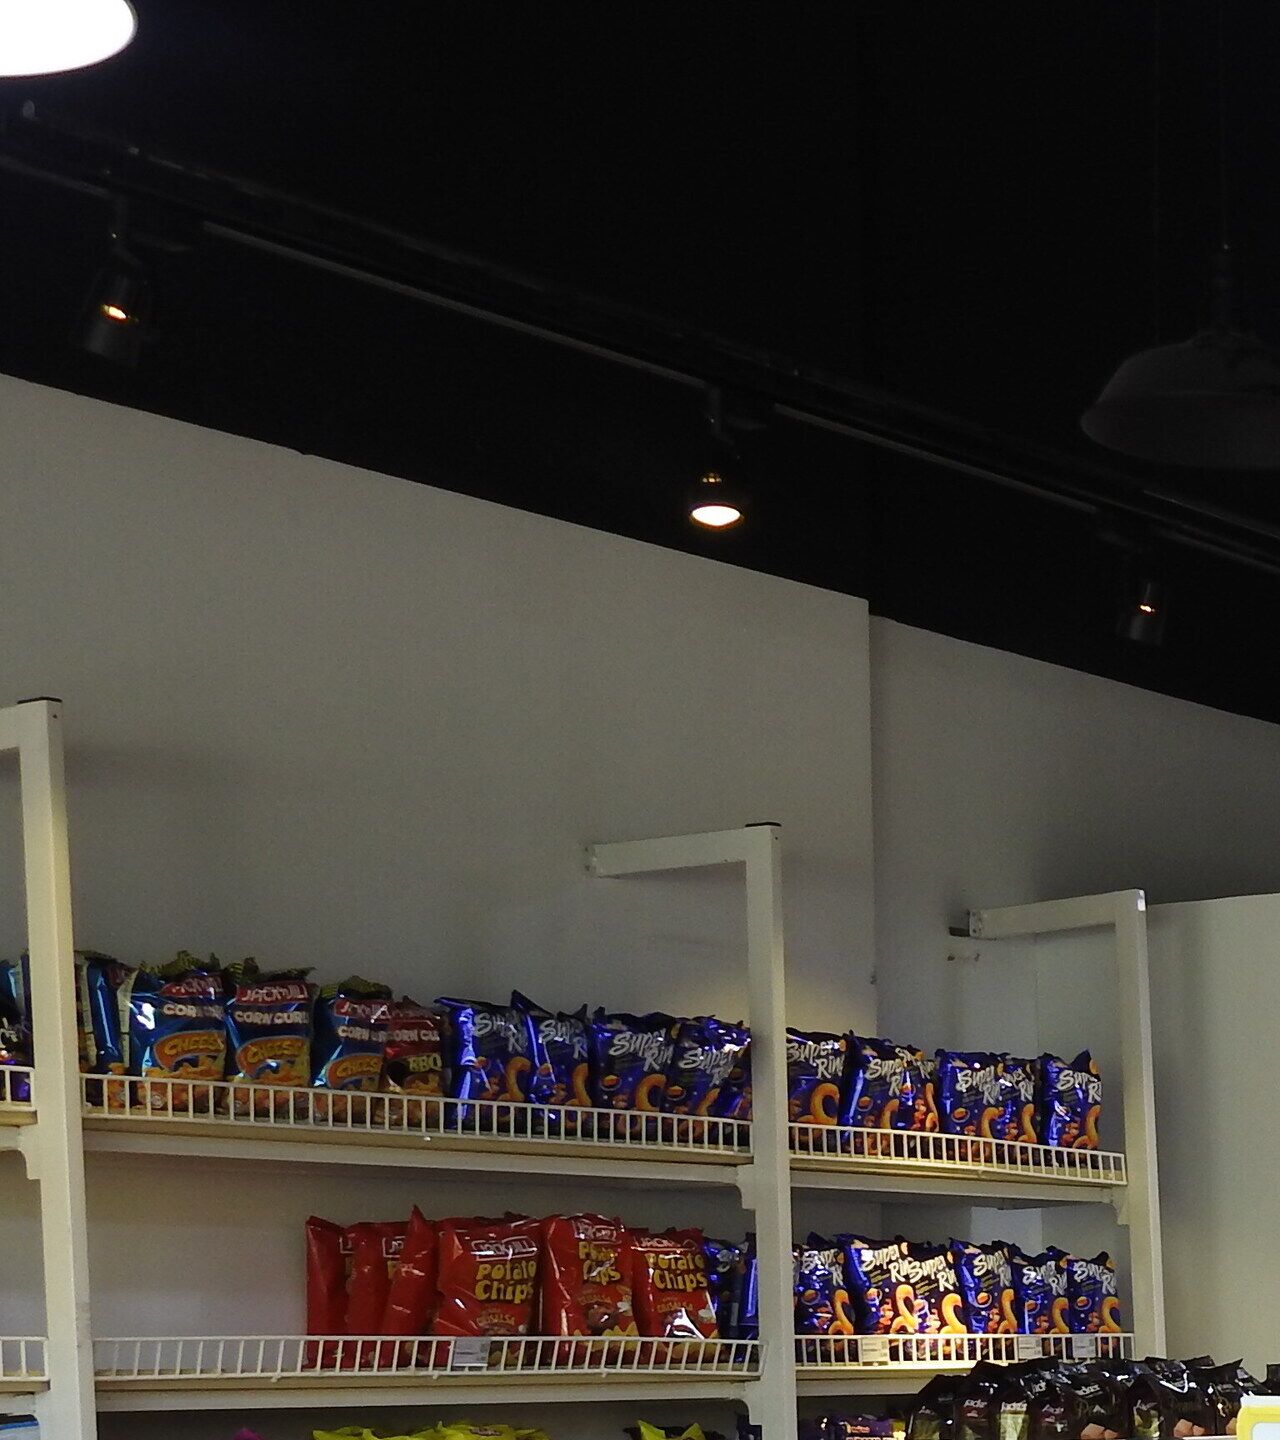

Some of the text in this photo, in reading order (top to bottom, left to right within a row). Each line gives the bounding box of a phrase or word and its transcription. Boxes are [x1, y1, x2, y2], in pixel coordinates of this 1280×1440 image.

[408, 1053, 443, 1071] BBQ
[645, 1250, 706, 1271] Potato
[475, 1261, 538, 1282] Potato
[653, 1269, 709, 1294] Chips
[474, 1279, 536, 1306] Chips
